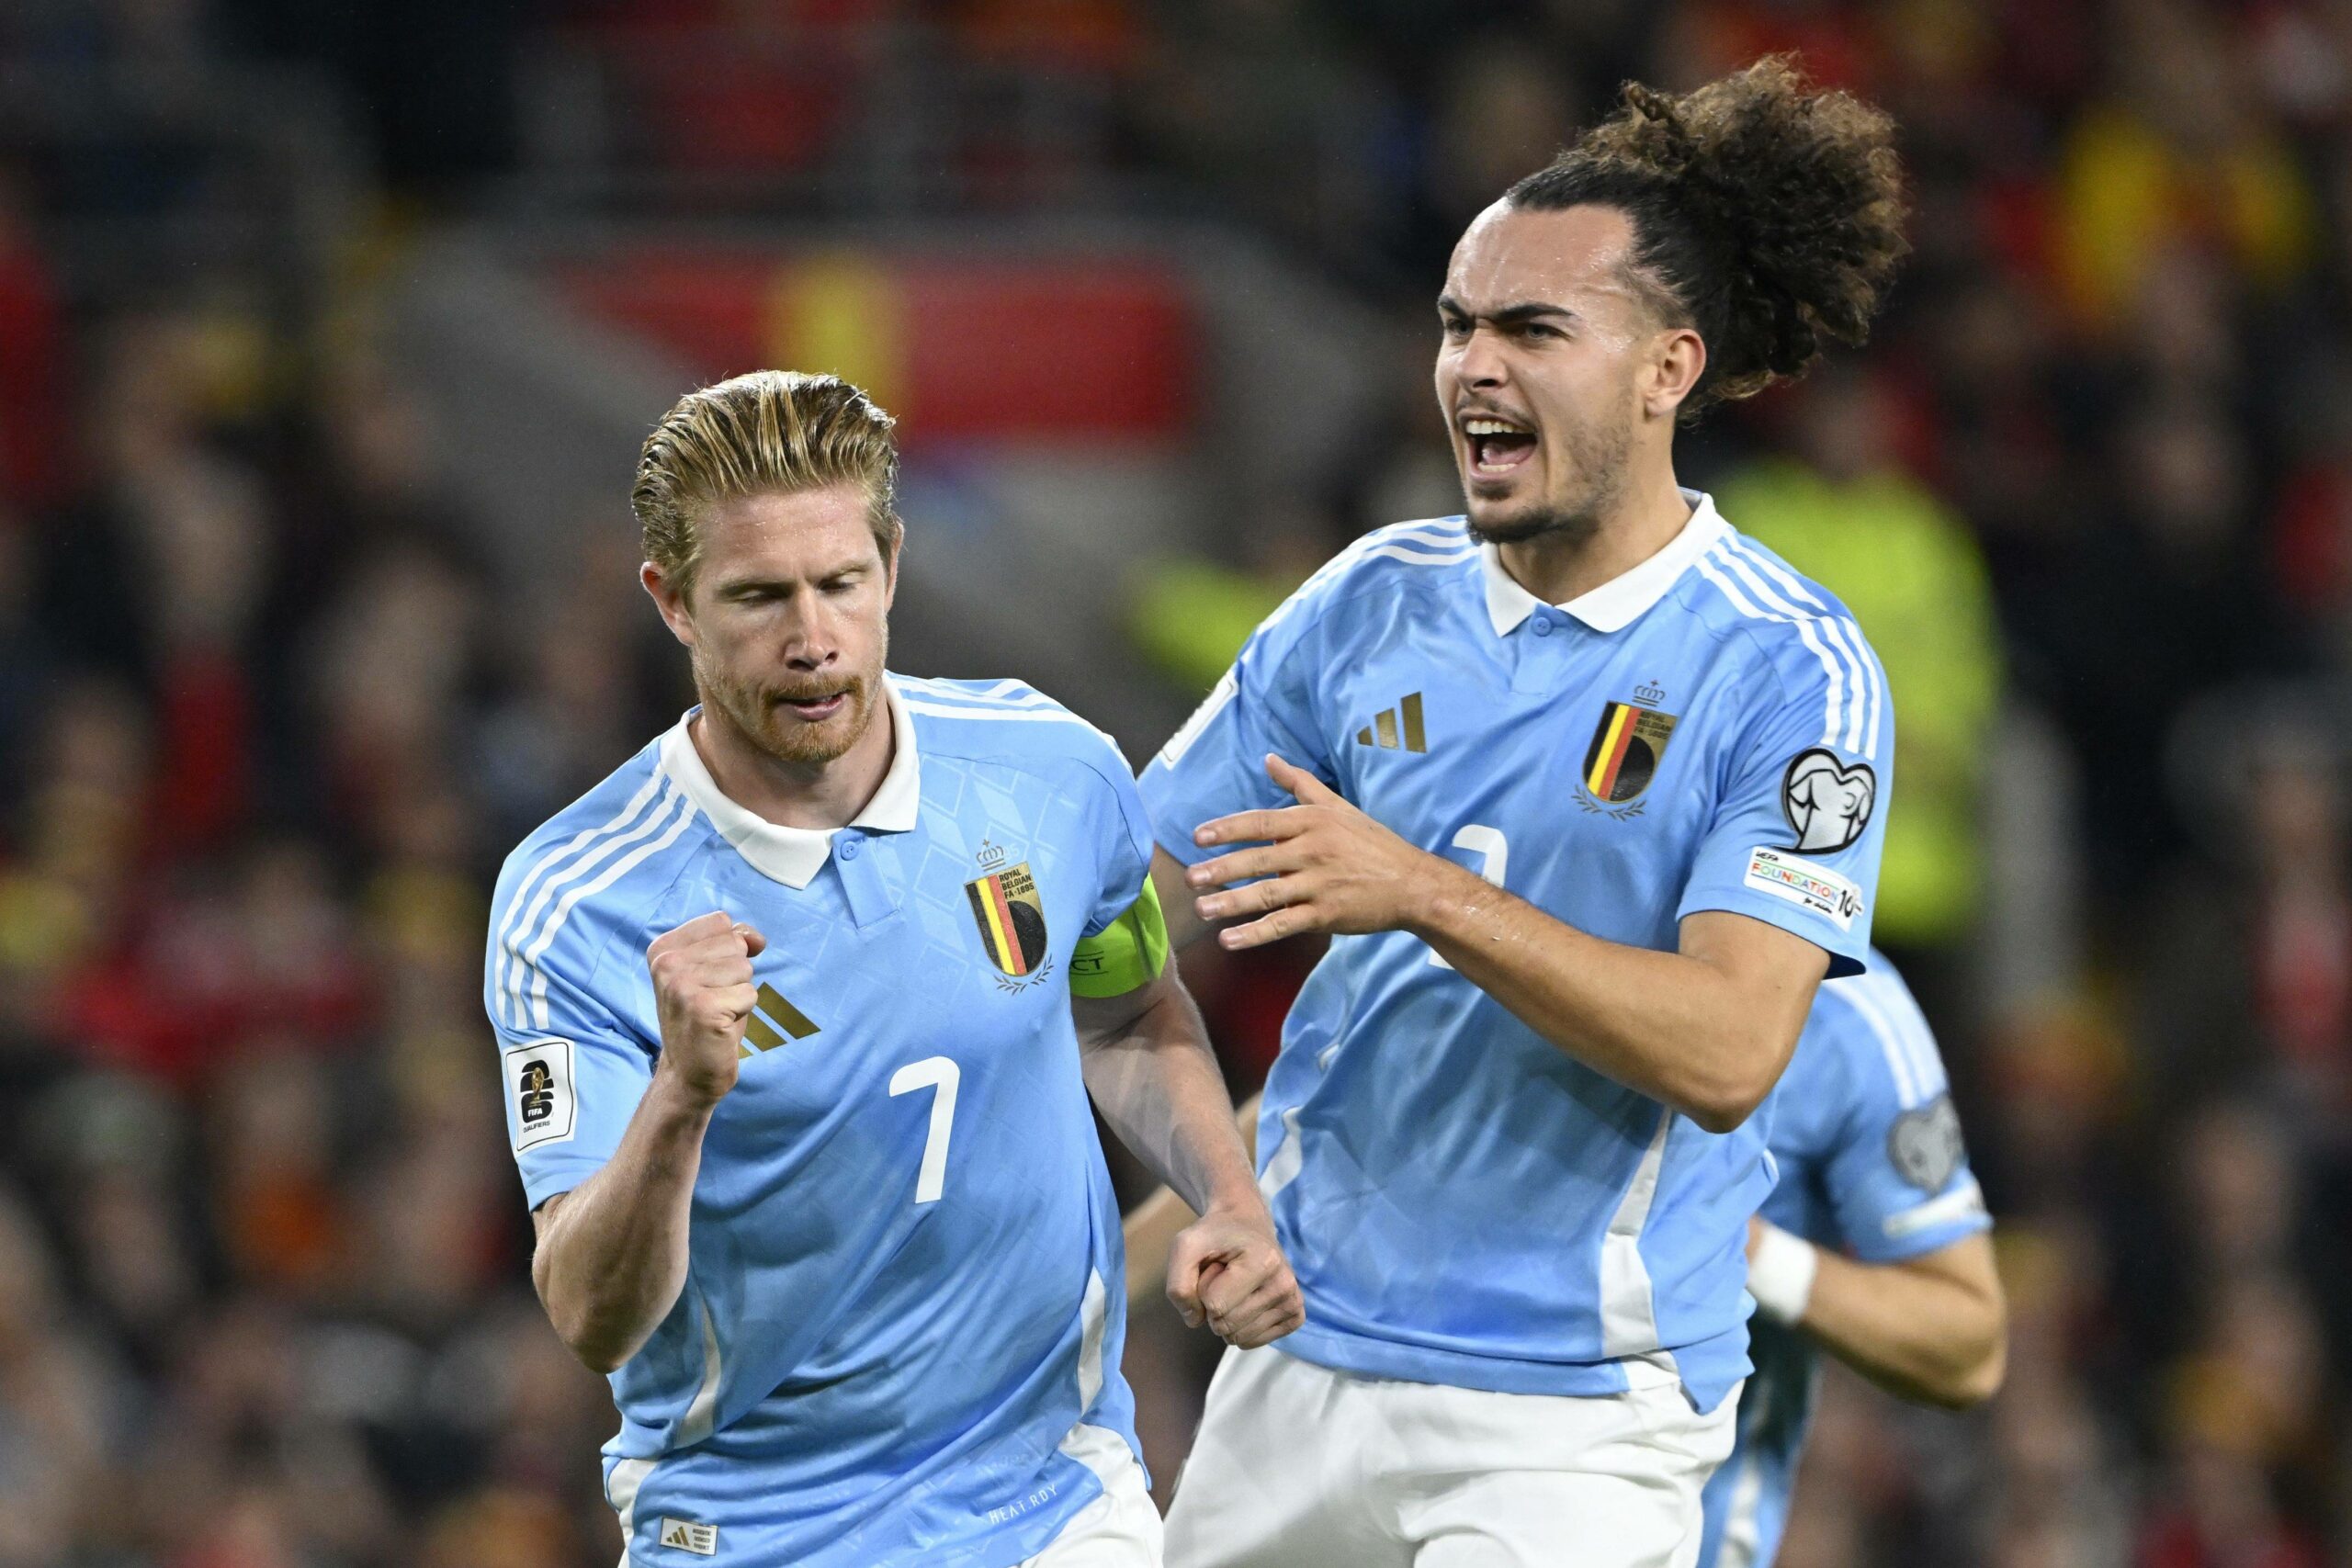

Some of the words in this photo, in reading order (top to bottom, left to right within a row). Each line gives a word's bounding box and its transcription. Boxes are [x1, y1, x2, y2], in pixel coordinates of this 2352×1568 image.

[999, 868, 1022, 882] ROYAL
[1001, 874, 1032, 891] BELGIAN
[1751, 863, 1838, 901] FOUNDATION
[527, 1108, 543, 1118] FIFA
[523, 1120, 551, 1134] QUALIFIERS
[889, 1055, 961, 1203] 7
